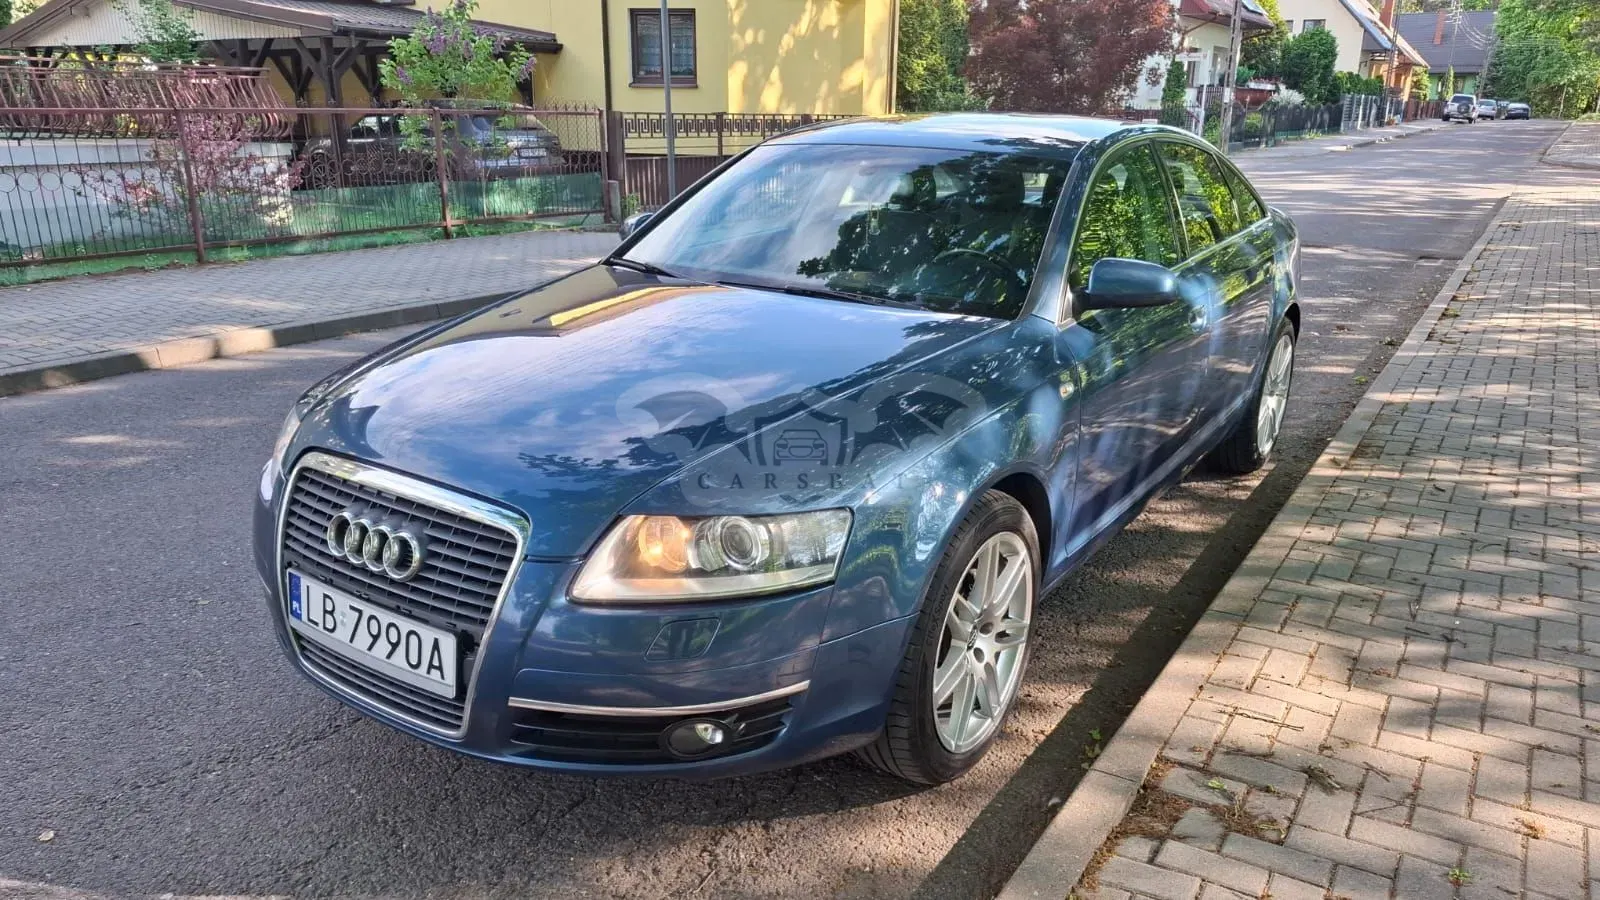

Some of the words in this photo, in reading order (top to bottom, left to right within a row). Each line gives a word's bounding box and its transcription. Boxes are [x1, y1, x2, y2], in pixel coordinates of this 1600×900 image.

[292, 600, 302, 614] PL
[306, 584, 338, 634] LB
[348, 603, 445, 681] 7990A
